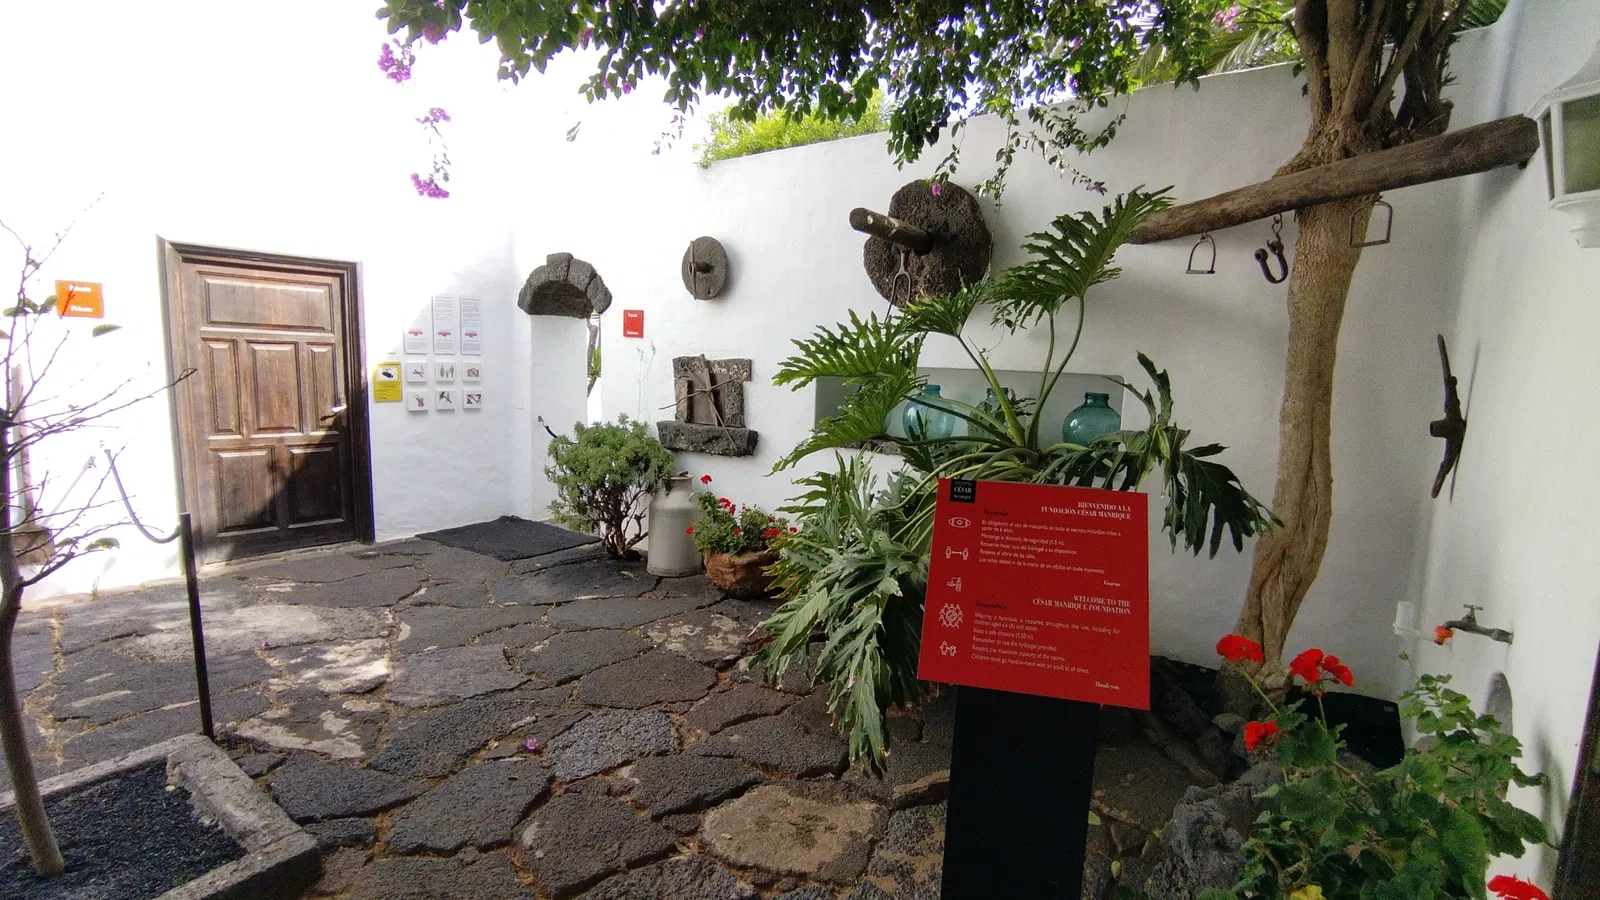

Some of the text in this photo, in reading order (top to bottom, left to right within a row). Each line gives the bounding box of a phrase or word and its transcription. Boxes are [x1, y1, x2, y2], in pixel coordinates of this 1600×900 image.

[1078, 502, 1116, 510] BIENVENIDO
[1041, 505, 1131, 521] FUNDACIÓN CÉSAR MANRIQUE
[1033, 596, 1131, 615] CÉSAR MANRIQUE FOUNDATION
[1074, 595, 1106, 604] WELCOME
[1108, 598, 1116, 606] TO
